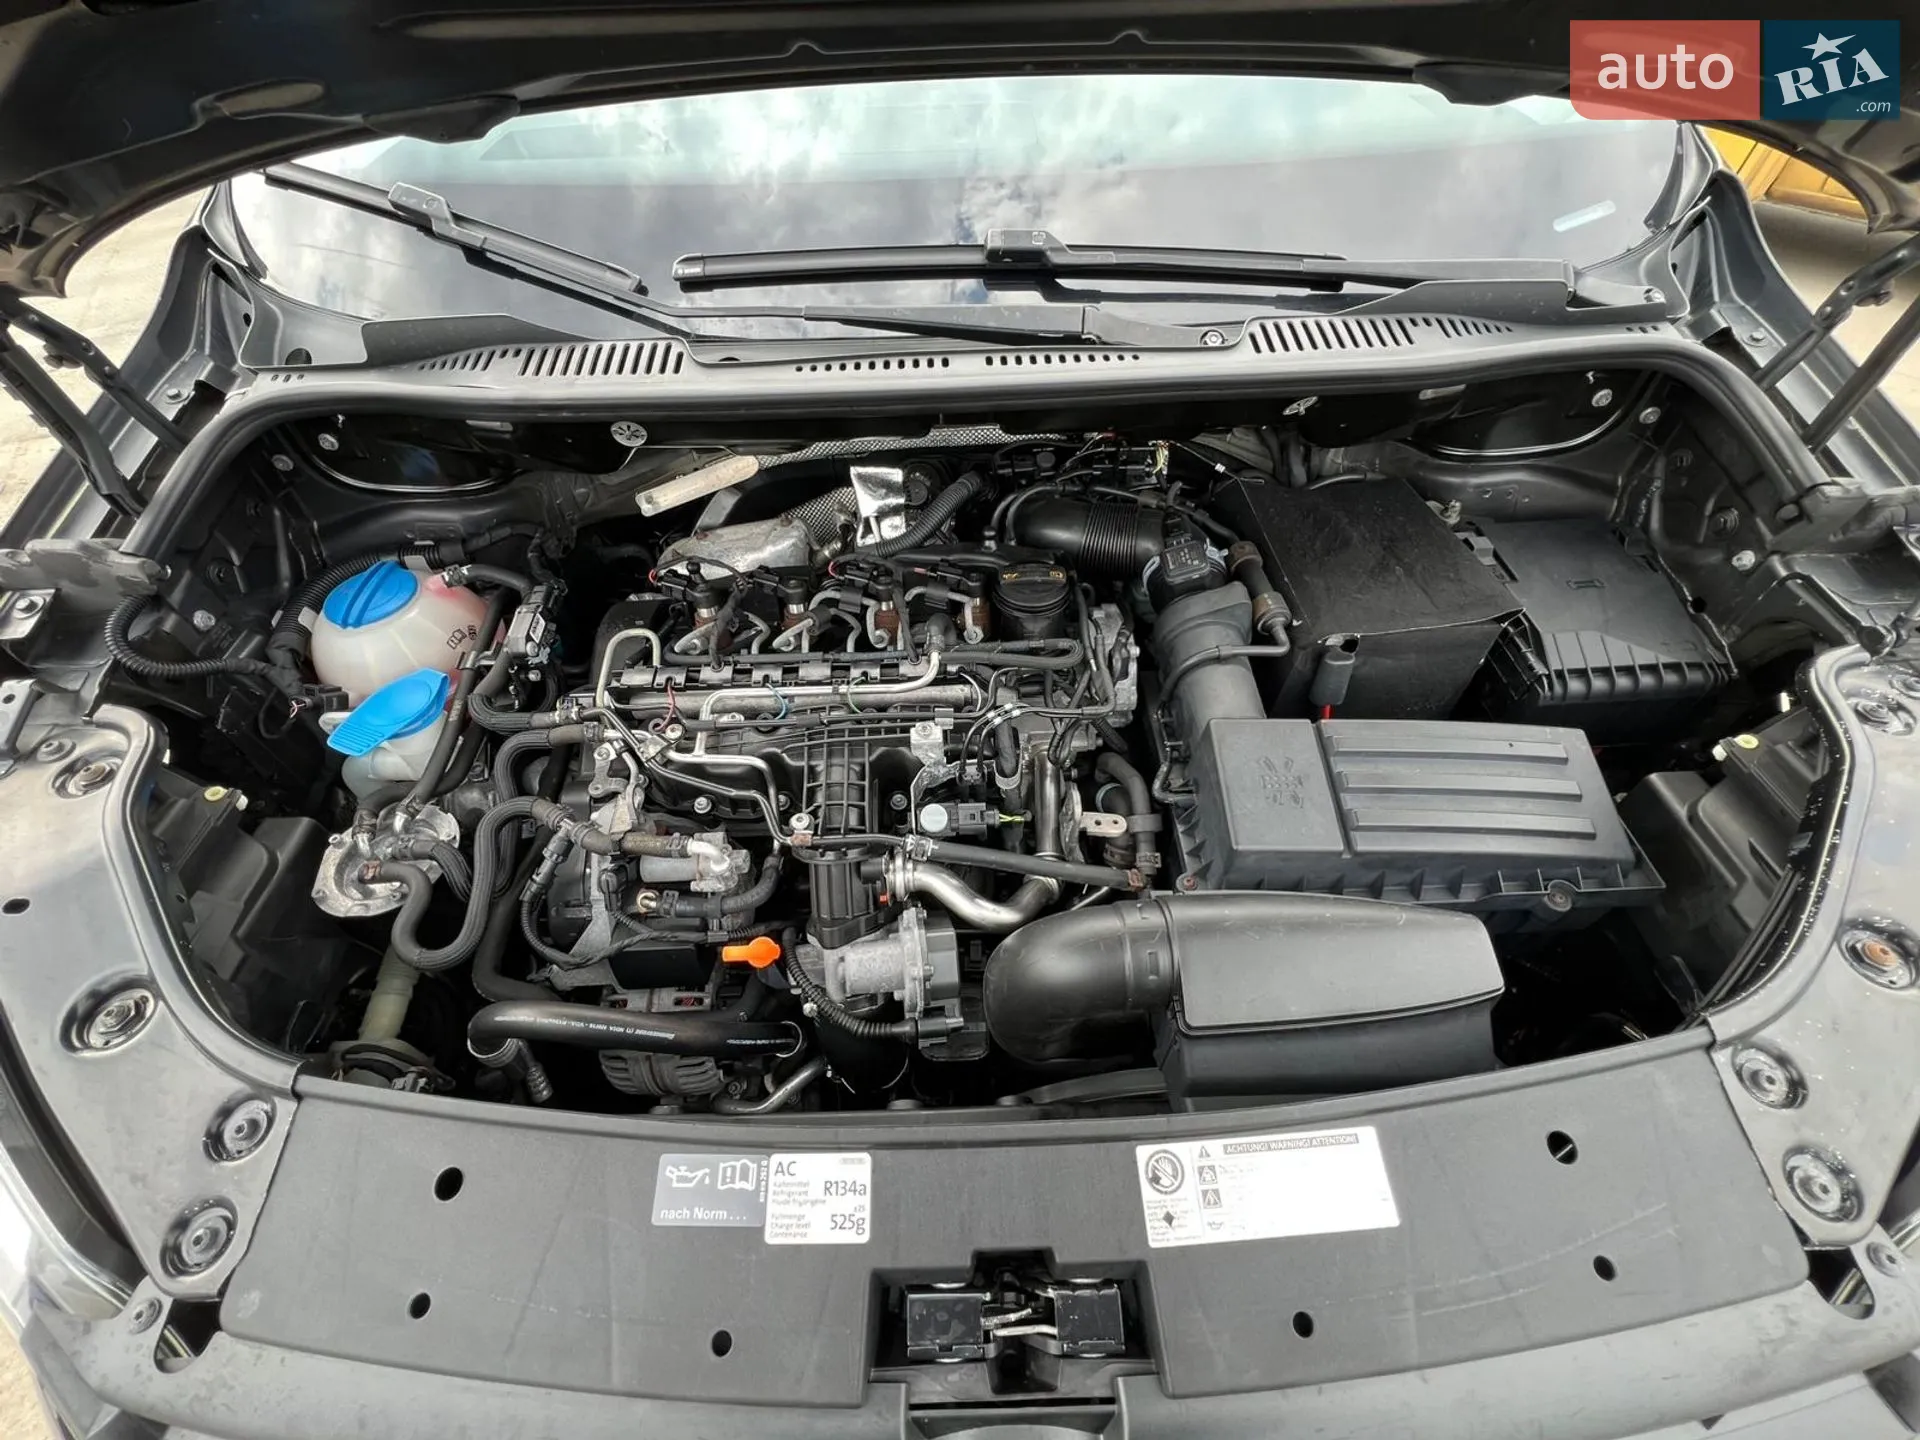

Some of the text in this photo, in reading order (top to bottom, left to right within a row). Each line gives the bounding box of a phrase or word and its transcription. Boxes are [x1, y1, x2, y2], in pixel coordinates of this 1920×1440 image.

[774, 1161, 797, 1176] AC
[824, 1180, 867, 1196] R134a
[660, 1206, 690, 1220] nach
[830, 1213, 866, 1236] 525g
